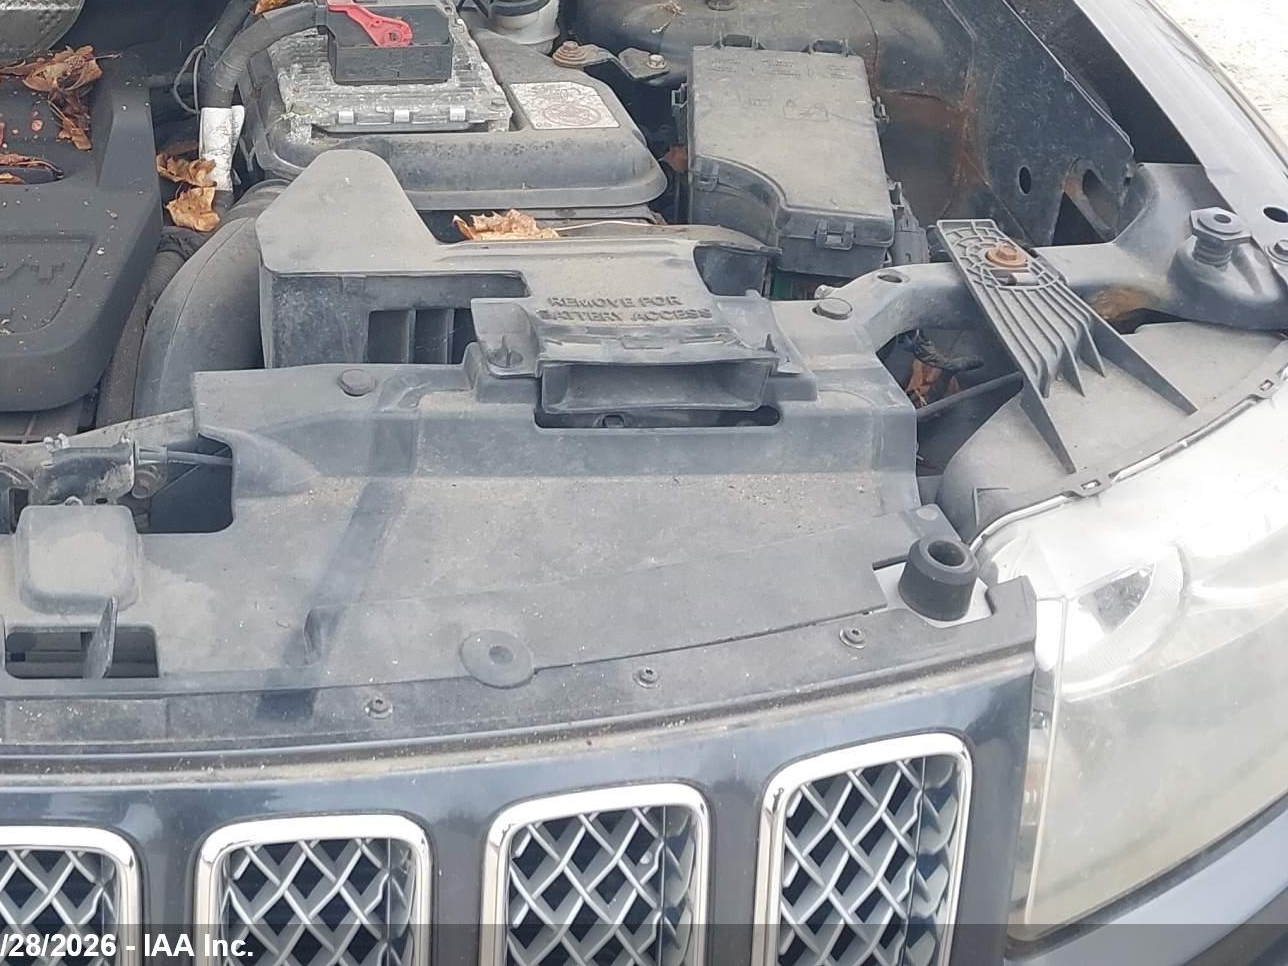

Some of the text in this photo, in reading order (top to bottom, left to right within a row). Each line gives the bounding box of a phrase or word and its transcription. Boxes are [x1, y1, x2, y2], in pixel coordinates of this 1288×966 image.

[548, 295, 683, 308] REMOVE FOR
[537, 308, 713, 322] BATTERY ACCESS
